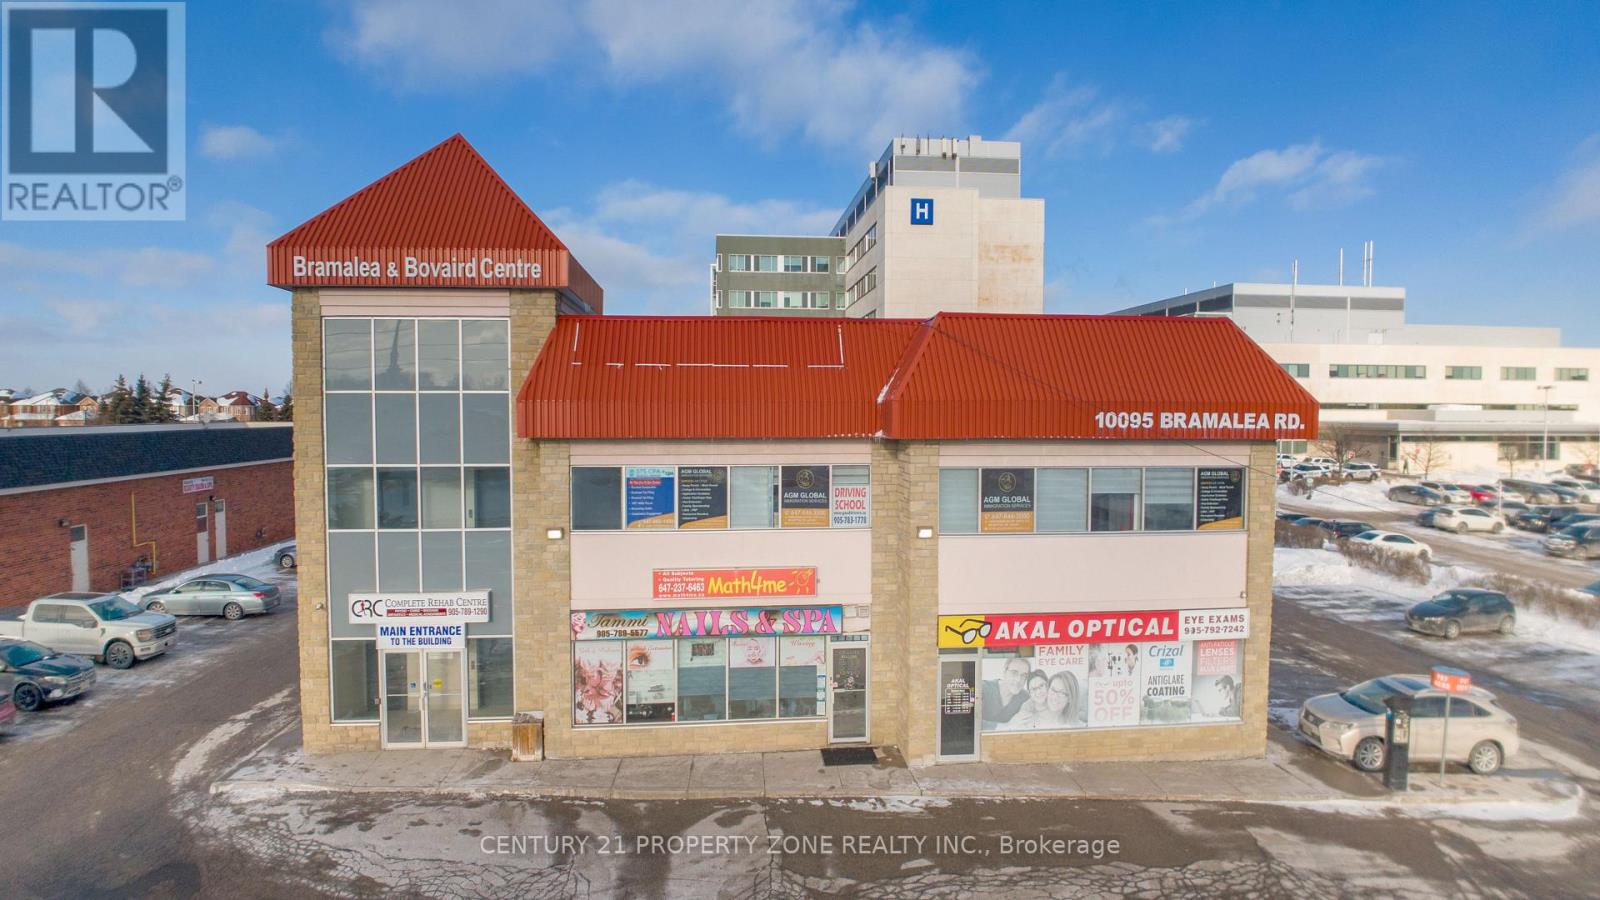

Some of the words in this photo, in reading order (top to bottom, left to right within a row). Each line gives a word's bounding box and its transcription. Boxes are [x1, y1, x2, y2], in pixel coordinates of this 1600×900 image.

[916, 202, 929, 219] H
[293, 256, 381, 277] Bramalea
[387, 261, 399, 277] &
[405, 257, 476, 277] Bovaird
[480, 257, 542, 279] Centre
[1095, 412, 1154, 429] 10095
[1160, 412, 1270, 429] BRAMALEA
[1274, 413, 1305, 430] RD.
[800, 491, 827, 499] GLOBAL
[835, 487, 867, 498] DRIVING
[835, 499, 867, 510] SCHOOL
[1001, 495, 1031, 503] GLOBAL
[707, 570, 788, 596] Math4me
[385, 598, 426, 608] COMPLETE
[428, 598, 454, 607] REHAB
[455, 597, 487, 607] CENTRE
[587, 614, 649, 628] Tammi
[655, 610, 750, 637] NAILS
[755, 609, 777, 635] &
[783, 608, 838, 634] SPA
[1184, 615, 1205, 625] EYE
[1209, 614, 1245, 624] EXAMS
[380, 626, 407, 636] MAIN
[409, 625, 462, 636] ENTRANCE
[994, 620, 1061, 640] AKAL
[1067, 616, 1175, 638] OPTICAL
[1184, 625, 1245, 635] 905-792-7242
[391, 638, 400, 646] TO
[418, 637, 452, 646] BUILDING
[1040, 645, 1084, 657] FAMILY
[1149, 644, 1184, 657] Crizal
[1200, 648, 1234, 657] LENSES
[1040, 658, 1057, 666] EYE
[1060, 657, 1084, 665] CARE
[1148, 674, 1184, 685] ANTIGLARE
[1147, 685, 1185, 697] COATING
[1093, 688, 1135, 706] 50%
[1093, 706, 1133, 721] OFF
